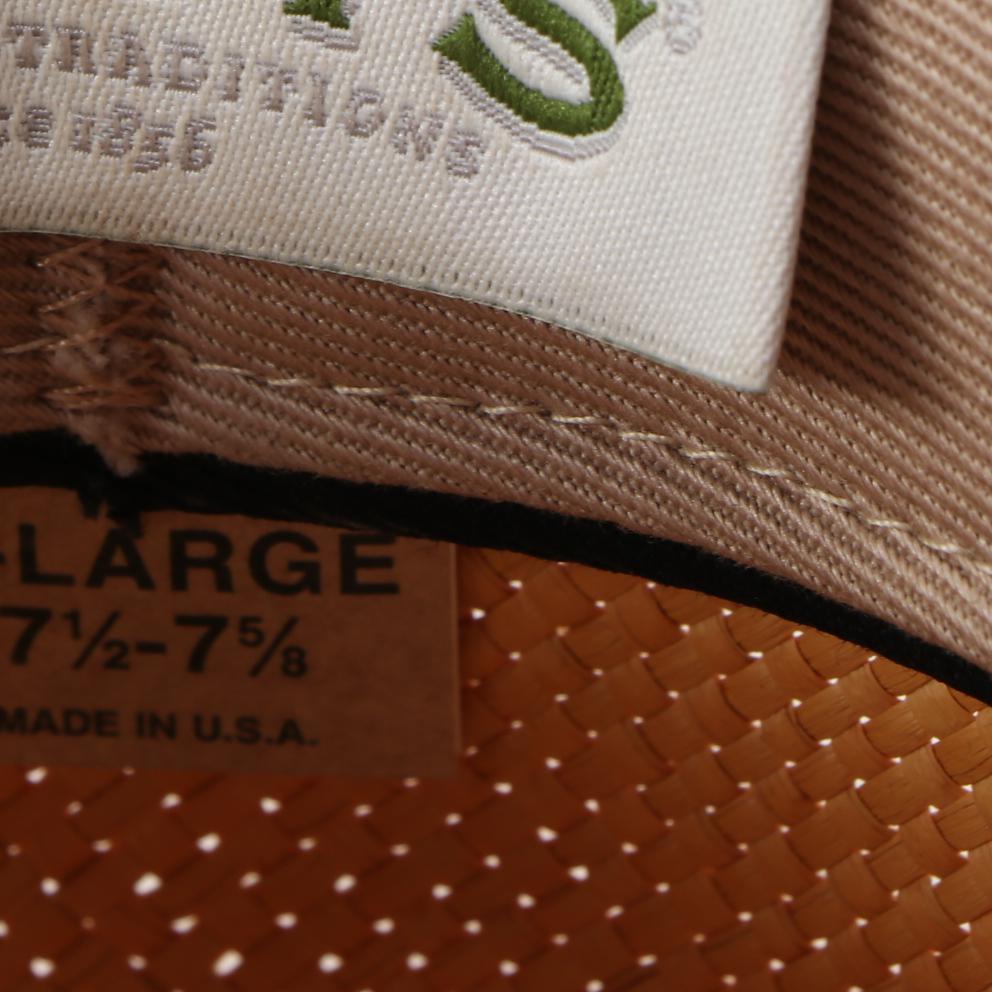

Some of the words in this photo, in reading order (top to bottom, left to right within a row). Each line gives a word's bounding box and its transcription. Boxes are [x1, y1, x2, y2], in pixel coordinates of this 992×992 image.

[8, 22, 486, 180] TRADITIONS
[68, 102, 218, 173] 1856
[136, 712, 177, 739] IN
[193, 715, 319, 747] U.S.A.
